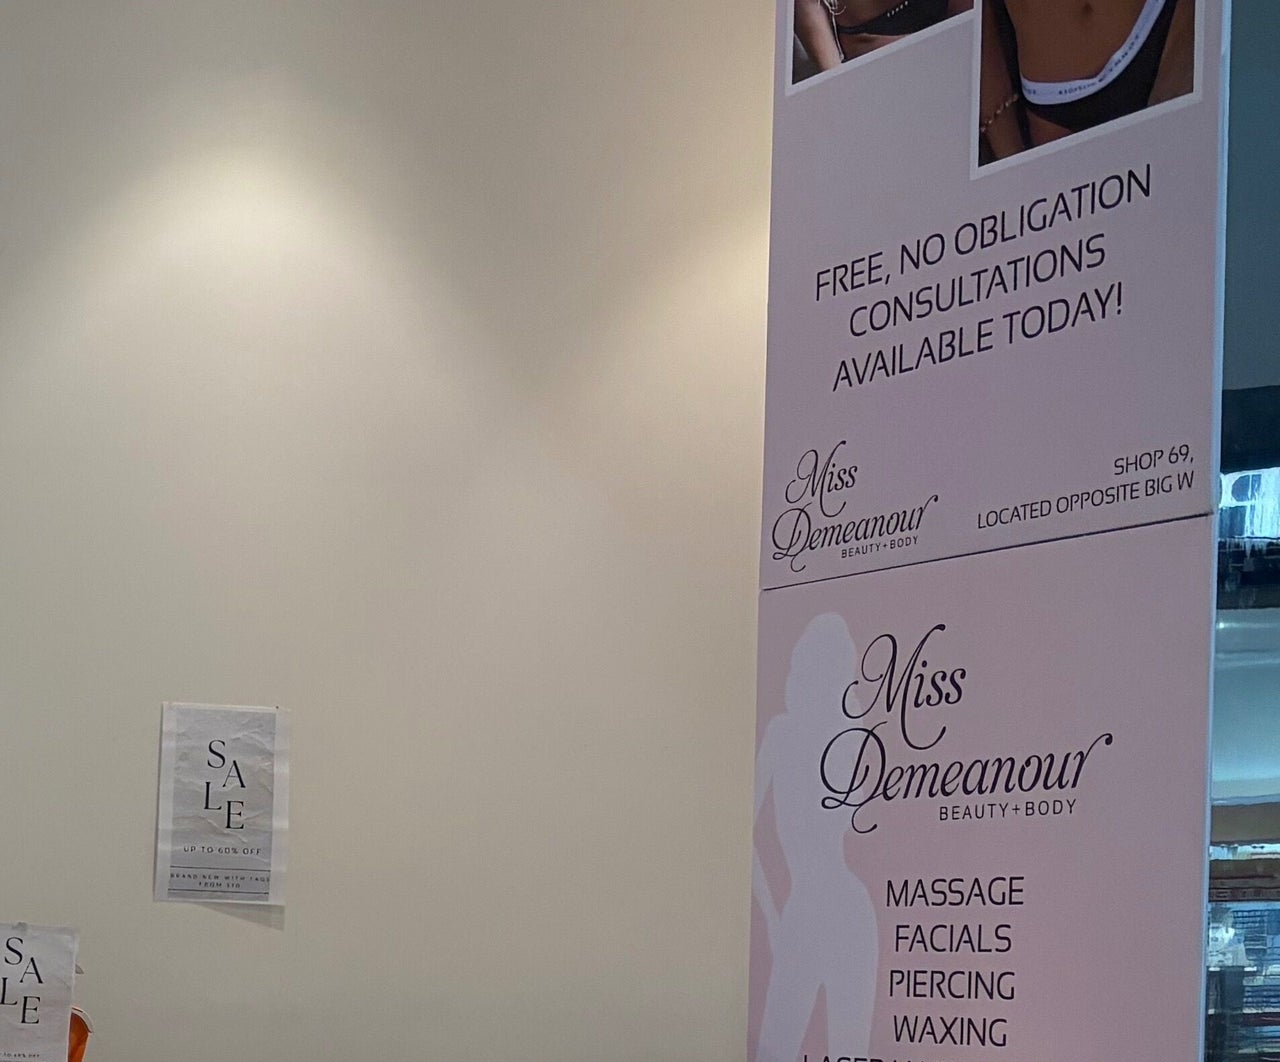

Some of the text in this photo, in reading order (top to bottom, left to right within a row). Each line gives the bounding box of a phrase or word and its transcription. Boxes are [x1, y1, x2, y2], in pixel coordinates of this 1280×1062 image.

[815, 164, 1152, 302] FREE, NO OBLIGATION
[849, 234, 1107, 338] CONSULTATIONS
[833, 282, 1124, 392] AVAILABLE TODAY!
[785, 441, 859, 518] Miss
[1114, 444, 1195, 476] SHOP 69,
[771, 495, 939, 573] Demeanour
[977, 470, 1196, 530] LOCATED OPPOSITE BIG W
[841, 624, 966, 750] Miss
[820, 721, 1113, 834] Demeanour
[201, 846, 214, 854] TO
[242, 847, 262, 856] OFF
[886, 876, 1025, 907] MASSAGE
[894, 924, 1012, 954] FACIALS
[889, 969, 1016, 1001] PIERCING
[893, 1015, 1008, 1048] WAXING
